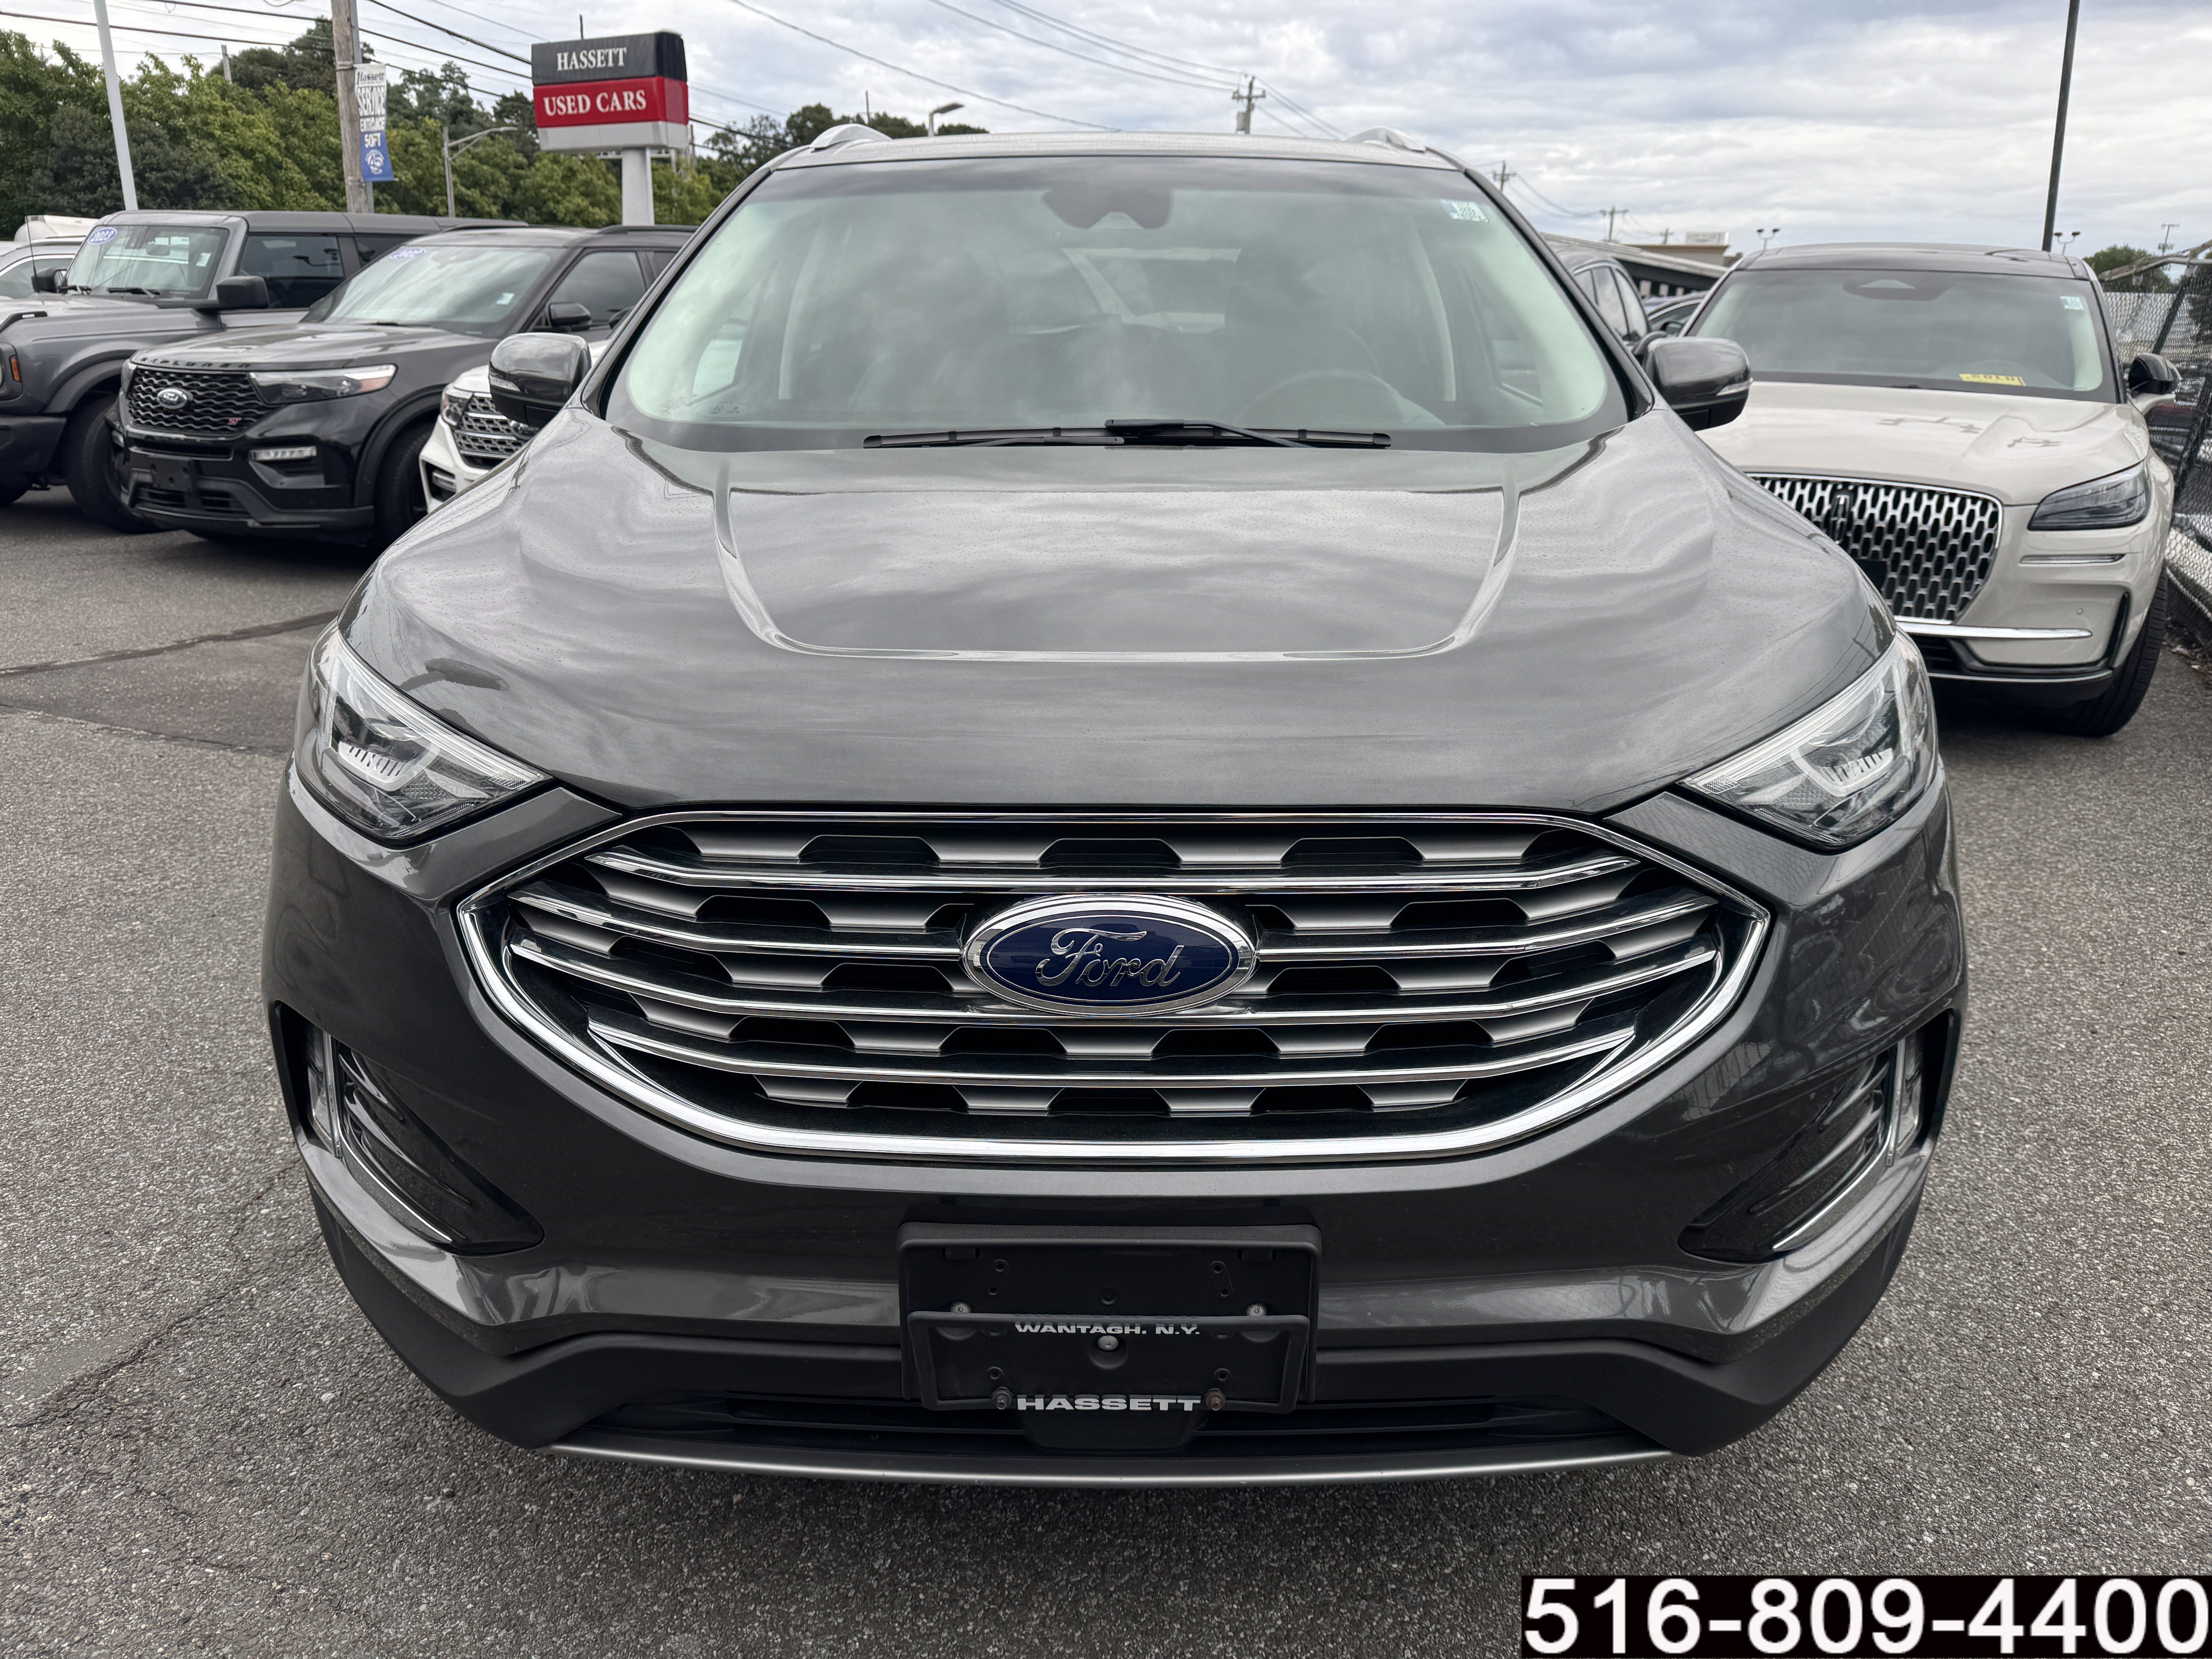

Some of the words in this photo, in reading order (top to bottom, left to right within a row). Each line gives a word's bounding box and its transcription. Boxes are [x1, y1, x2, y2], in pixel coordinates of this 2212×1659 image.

[556, 47, 627, 71] HASSETT
[543, 94, 591, 117] USED
[596, 89, 647, 113] CARS
[90, 230, 114, 242] 2023
[140, 357, 251, 368] EXPLORER
[228, 417, 242, 426] ST
[1035, 928, 1185, 987] Ford
[1155, 1324, 1200, 1334] N.Y.
[1017, 1396, 1201, 1411] HASSETT
